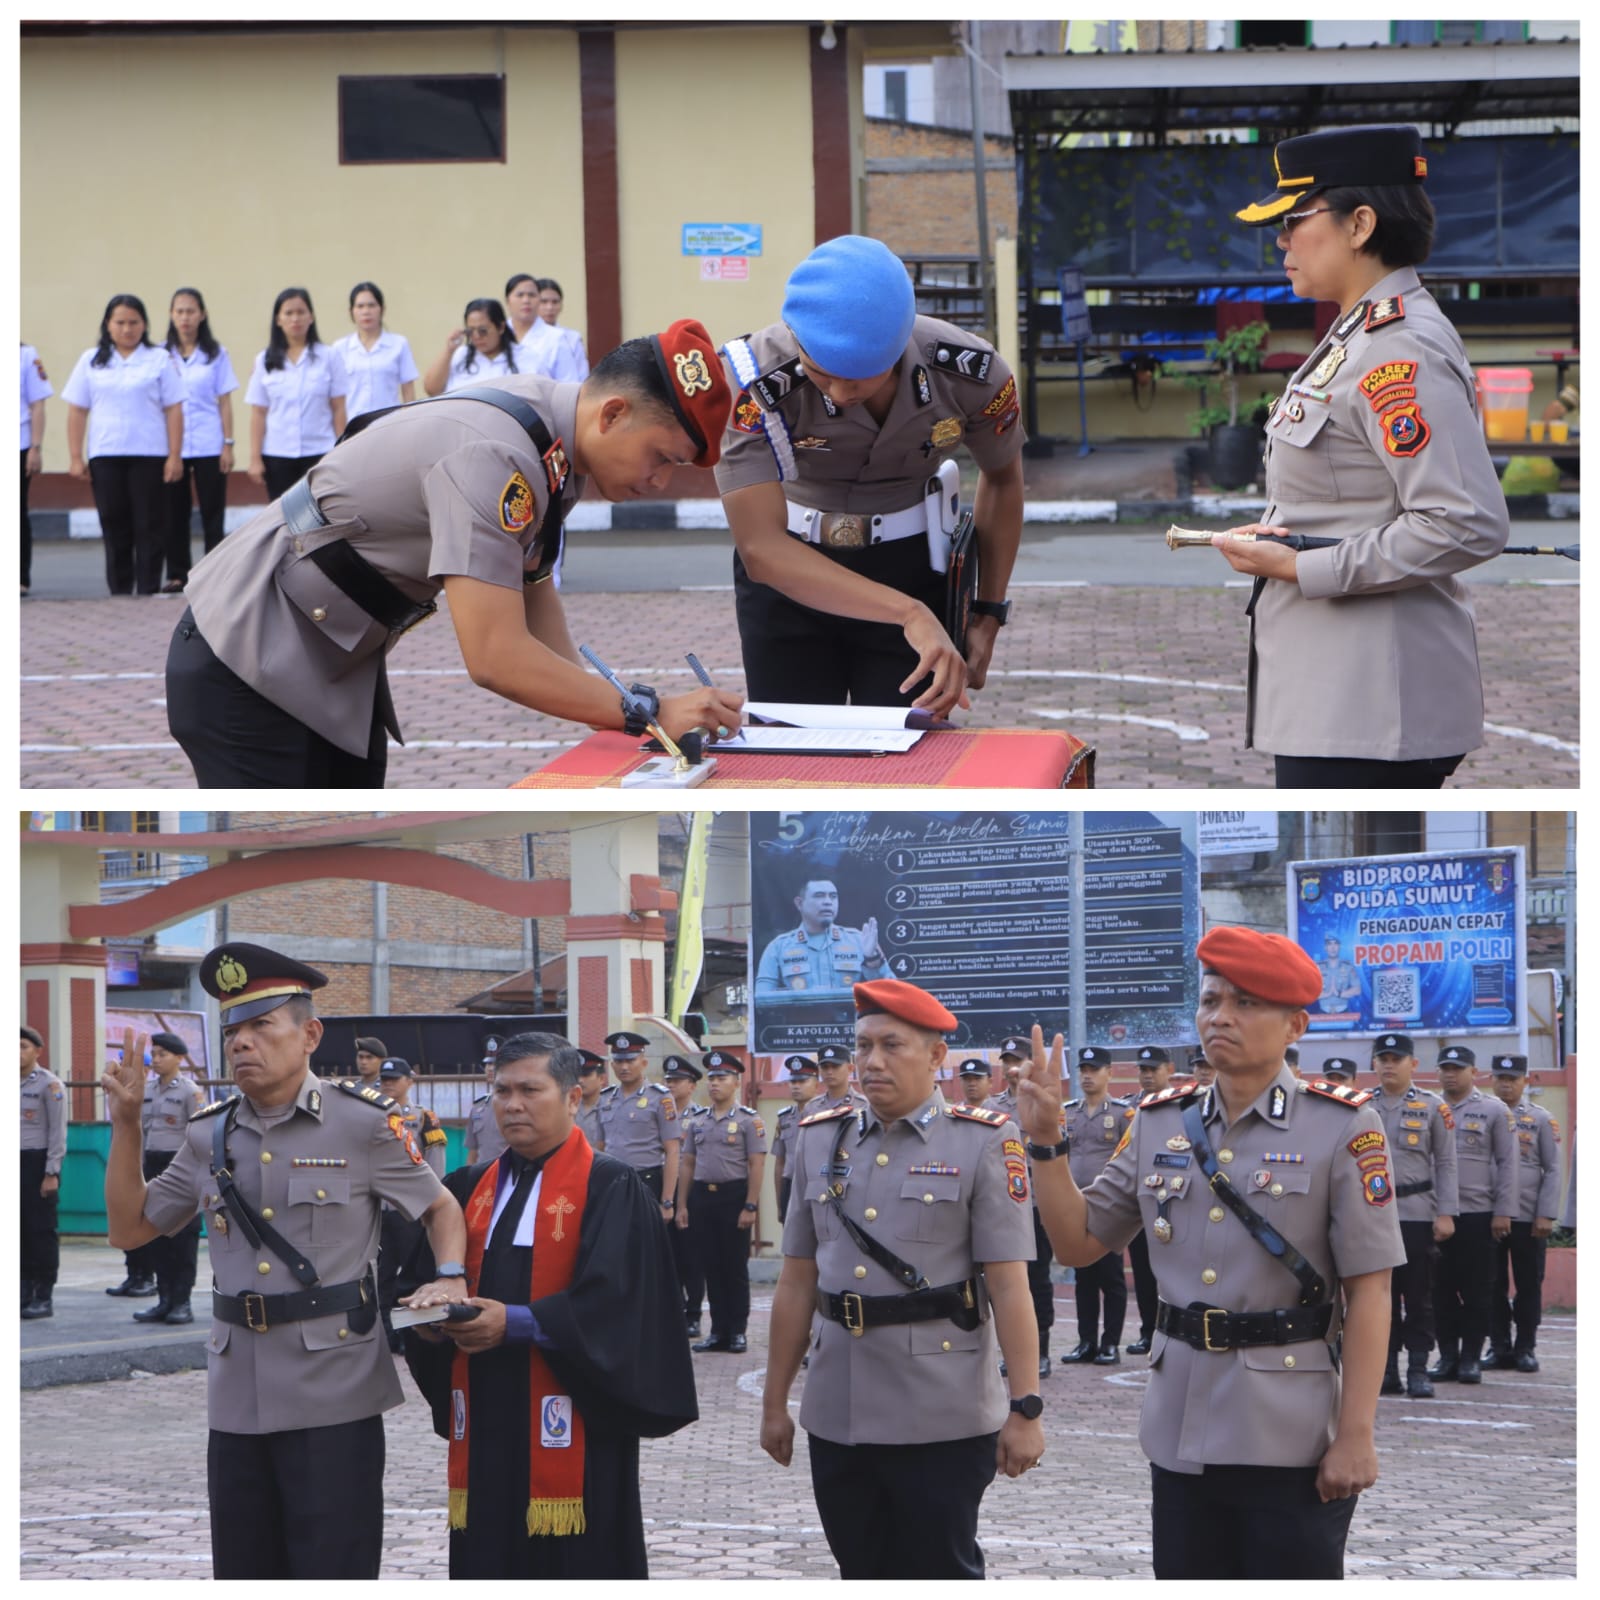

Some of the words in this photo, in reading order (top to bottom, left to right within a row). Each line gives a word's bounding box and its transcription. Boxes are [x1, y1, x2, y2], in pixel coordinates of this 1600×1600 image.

[1363, 364, 1411, 390] POLRES
[779, 811, 805, 841] 5
[824, 811, 869, 830] Arah
[824, 825, 916, 853] Kebijakan
[923, 817, 1001, 844] Kapolda
[918, 850, 967, 859] Laksanakan
[969, 848, 994, 857] setiap
[996, 846, 1019, 855] tugas
[1021, 844, 1053, 853] dengan
[1087, 839, 1132, 848] Utamakan
[896, 855, 905, 867] 1
[918, 857, 938, 865] demi
[941, 856, 979, 864] kebaikan
[919, 885, 961, 893] Utamakan
[1010, 880, 1033, 888] yang
[1102, 873, 1147, 882] mencegah
[1149, 871, 1168, 879] dan
[1343, 862, 1464, 887] BIDPROPAM
[895, 891, 907, 904] 2
[919, 891, 961, 900] mengatasi
[962, 889, 992, 898] potensi
[1117, 880, 1162, 889] gangguan
[1333, 889, 1398, 910] POLDA
[1404, 884, 1476, 907] SUMUT
[950, 921, 974, 930] under
[976, 919, 1012, 928] estimate
[1014, 917, 1041, 926] segala
[970, 927, 1005, 935] lakukan
[1007, 925, 1033, 933] sesuai
[1358, 916, 1452, 935] PENGADUAN
[1456, 913, 1505, 930] CEPAT
[896, 926, 908, 939] 3
[919, 958, 952, 966] Lakukan
[953, 957, 994, 966] penegakan
[996, 955, 1024, 963] hukum
[1025, 954, 1050, 962] secara
[1153, 948, 1174, 956] serta
[1355, 941, 1443, 965] PROPAM
[1450, 937, 1512, 960] POLRI
[896, 960, 908, 973] 4
[919, 964, 957, 973] utamakan
[959, 963, 992, 971] keadilan
[993, 961, 1016, 970] untuk
[969, 991, 1005, 1000] Soliditas
[1007, 989, 1039, 999] dengan
[1141, 984, 1170, 993] Tokoh
[786, 1027, 841, 1036] KAPOLDA
[1402, 1109, 1429, 1119] POLRI
[1463, 1112, 1488, 1121] POLRI
